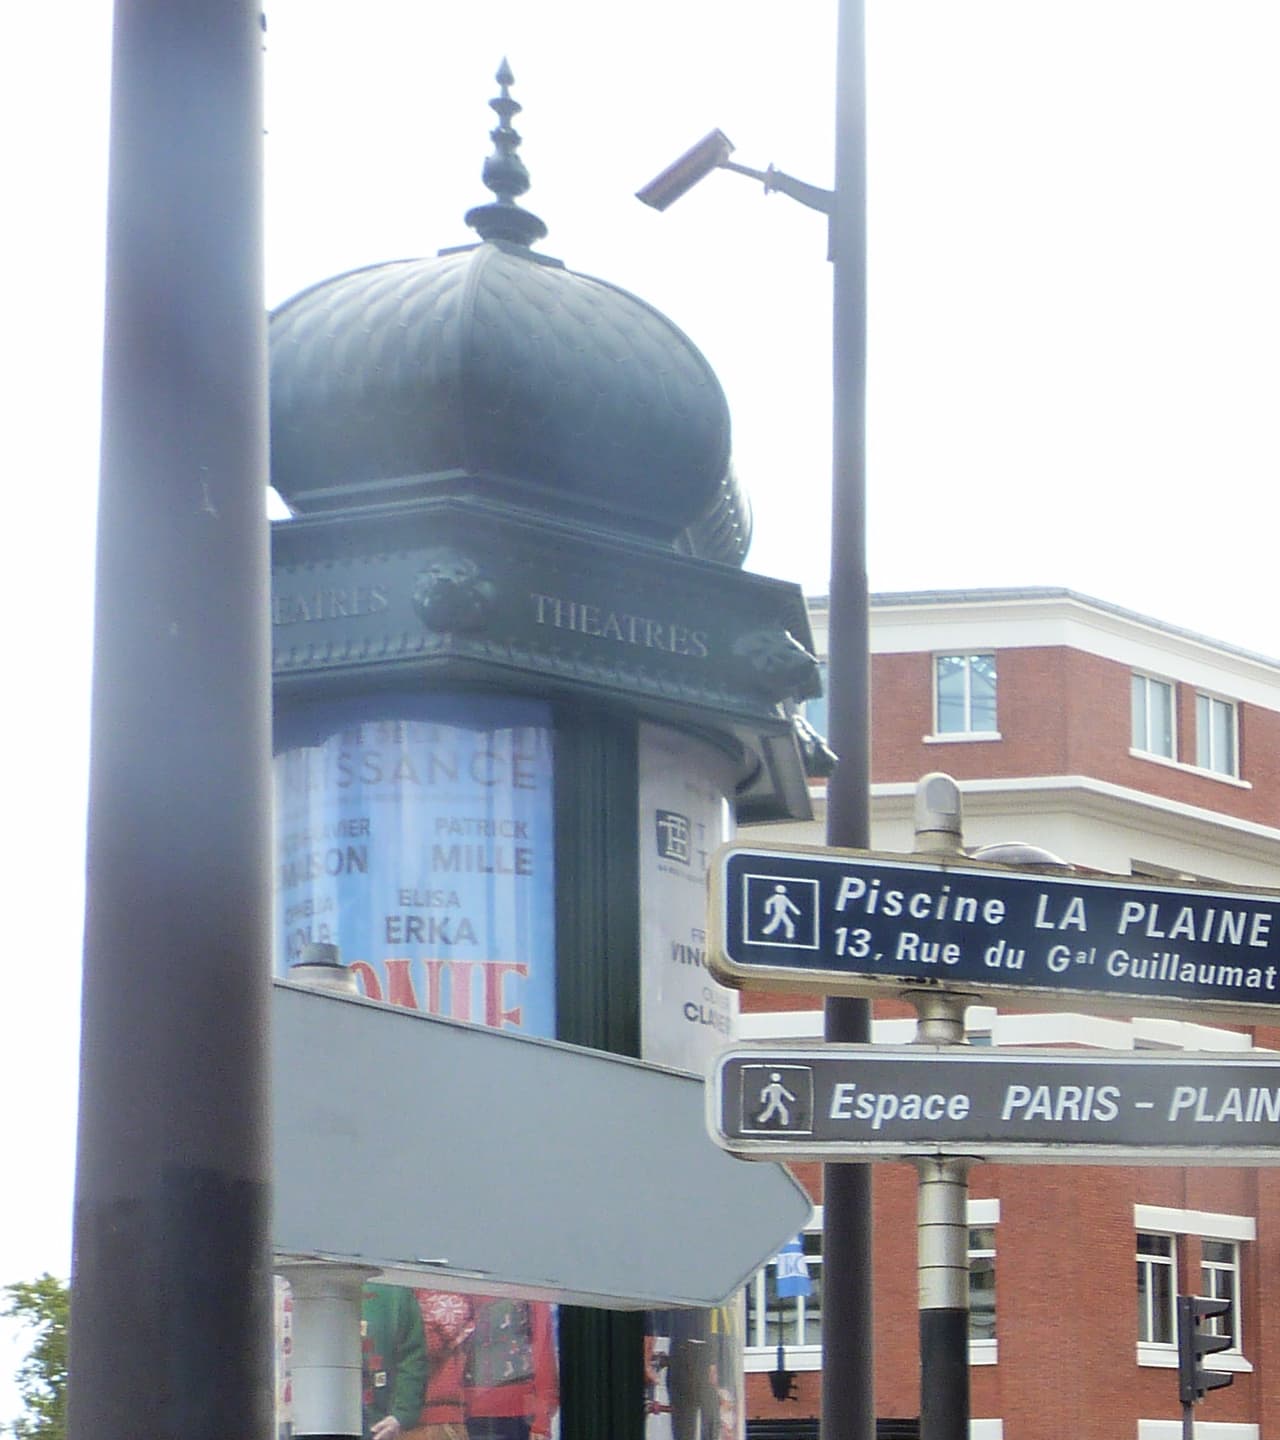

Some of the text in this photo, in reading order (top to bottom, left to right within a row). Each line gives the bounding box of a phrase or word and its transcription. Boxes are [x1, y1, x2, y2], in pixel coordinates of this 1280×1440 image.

[531, 592, 708, 657] THEATRES
[435, 818, 528, 839] PATRICK
[432, 845, 534, 876] MILLE
[385, 916, 478, 944] ERKA
[835, 877, 1272, 948] Piscine LA PLAINE
[834, 927, 1278, 991] 13, Rue du Gal Guillaumat
[829, 1084, 970, 1129] Espace
[1001, 1085, 1121, 1122] PARIS
